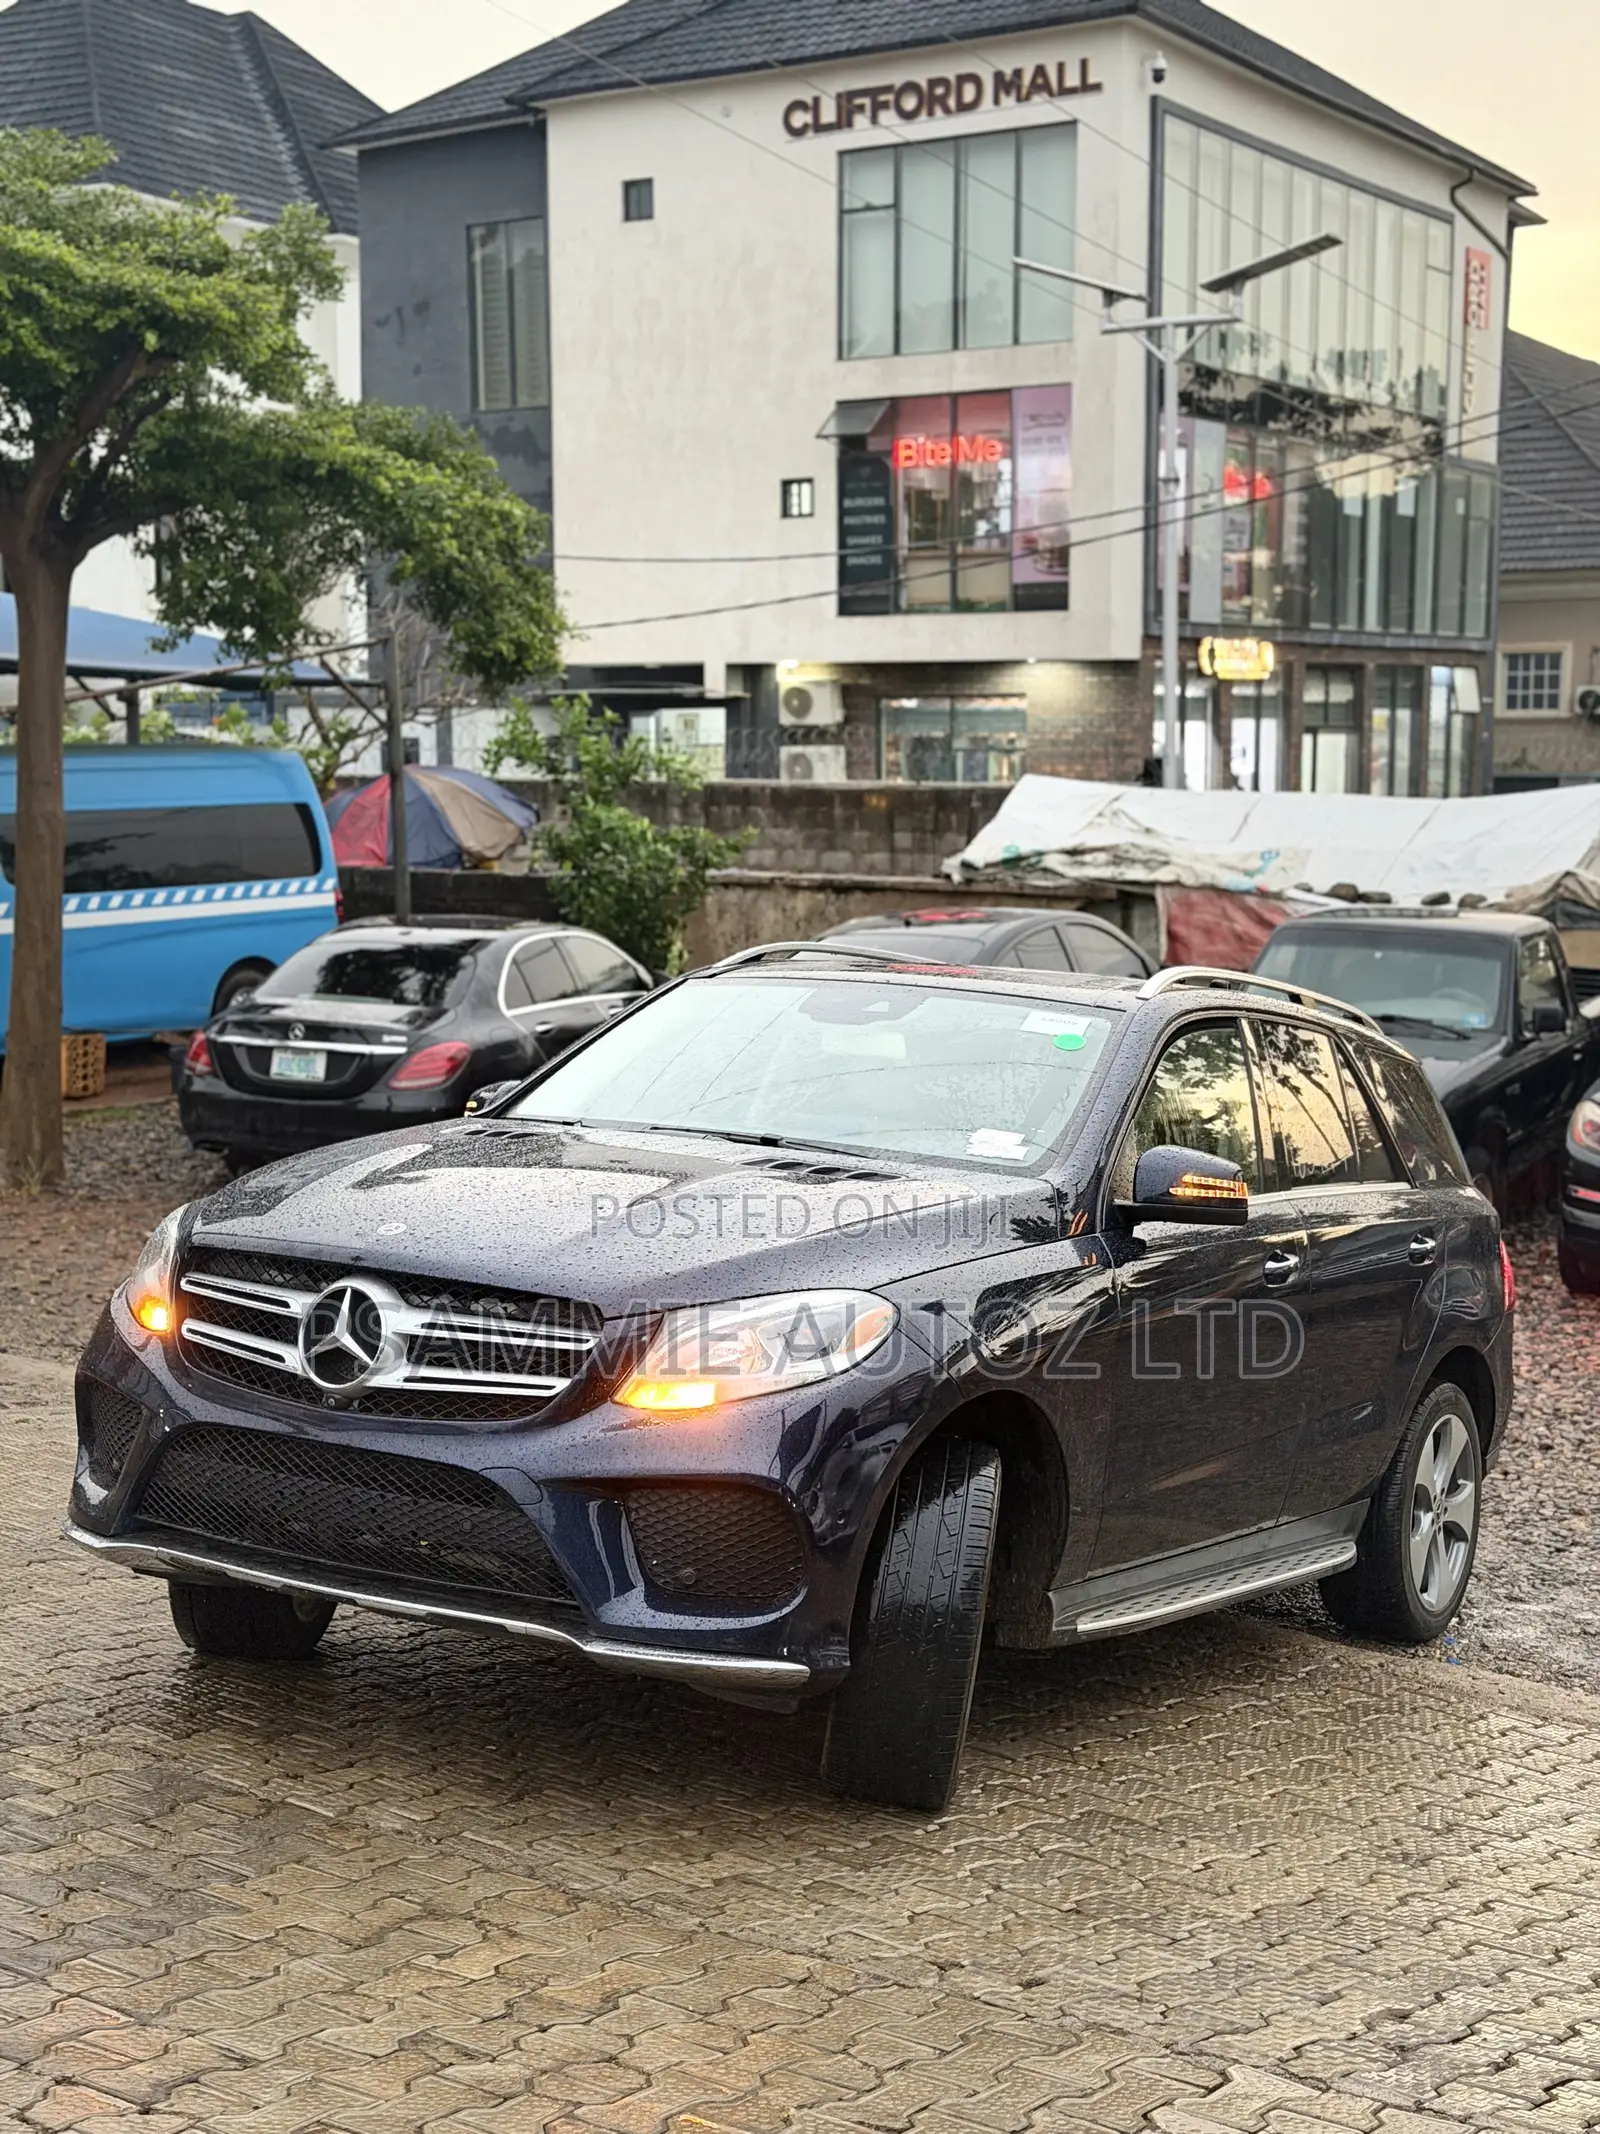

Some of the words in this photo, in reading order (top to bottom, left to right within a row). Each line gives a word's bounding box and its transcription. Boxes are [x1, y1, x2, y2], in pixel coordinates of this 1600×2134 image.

[783, 72, 984, 137] CLIFFORD
[993, 57, 1102, 107] MALL
[895, 437, 952, 468] Bite
[953, 434, 1003, 464] Me
